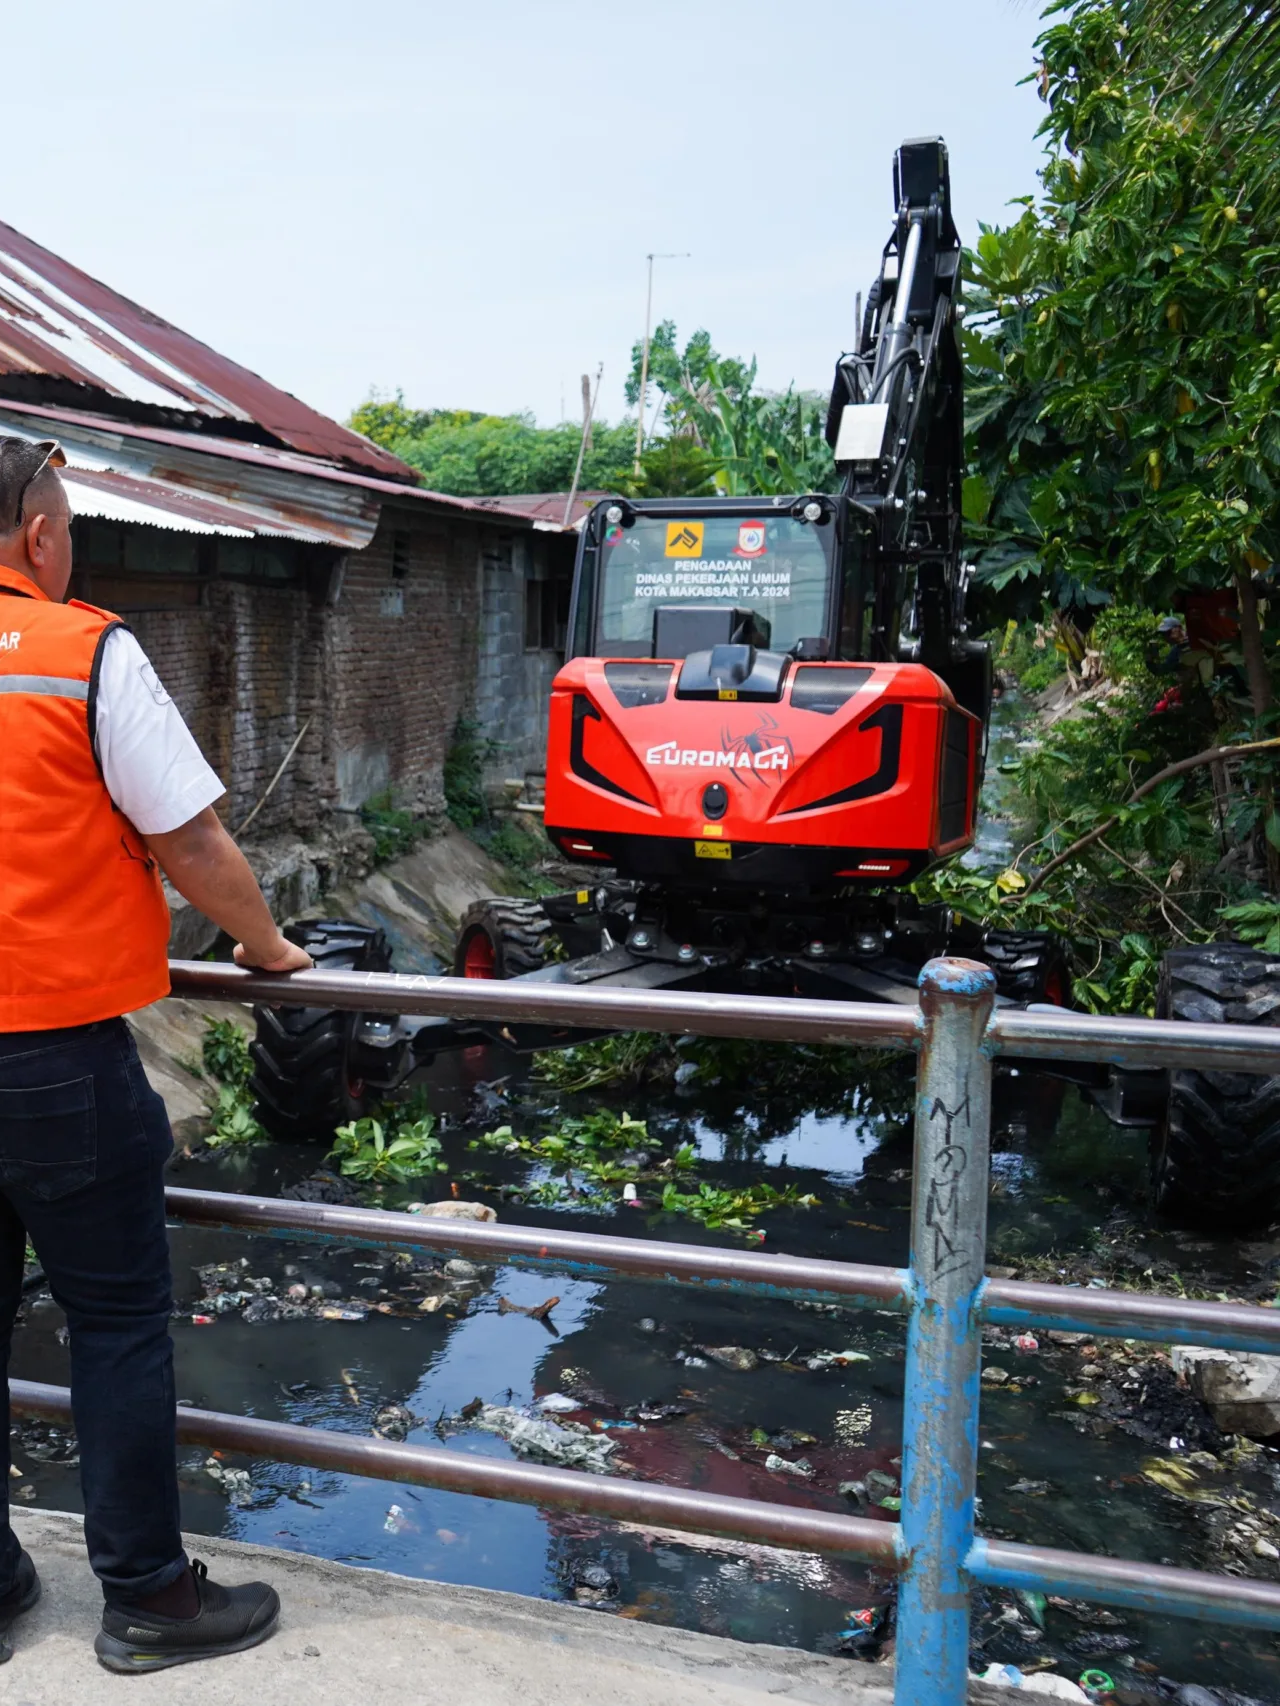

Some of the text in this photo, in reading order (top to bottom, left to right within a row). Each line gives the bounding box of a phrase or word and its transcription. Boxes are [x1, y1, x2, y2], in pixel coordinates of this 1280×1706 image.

[674, 560, 751, 571] PENGADAAN
[636, 573, 791, 584] DINAS PEKERJAAN UMUM
[635, 586, 790, 597] KOTA MAKASSAR T.A 2024
[646, 740, 789, 770] EUROMACH
